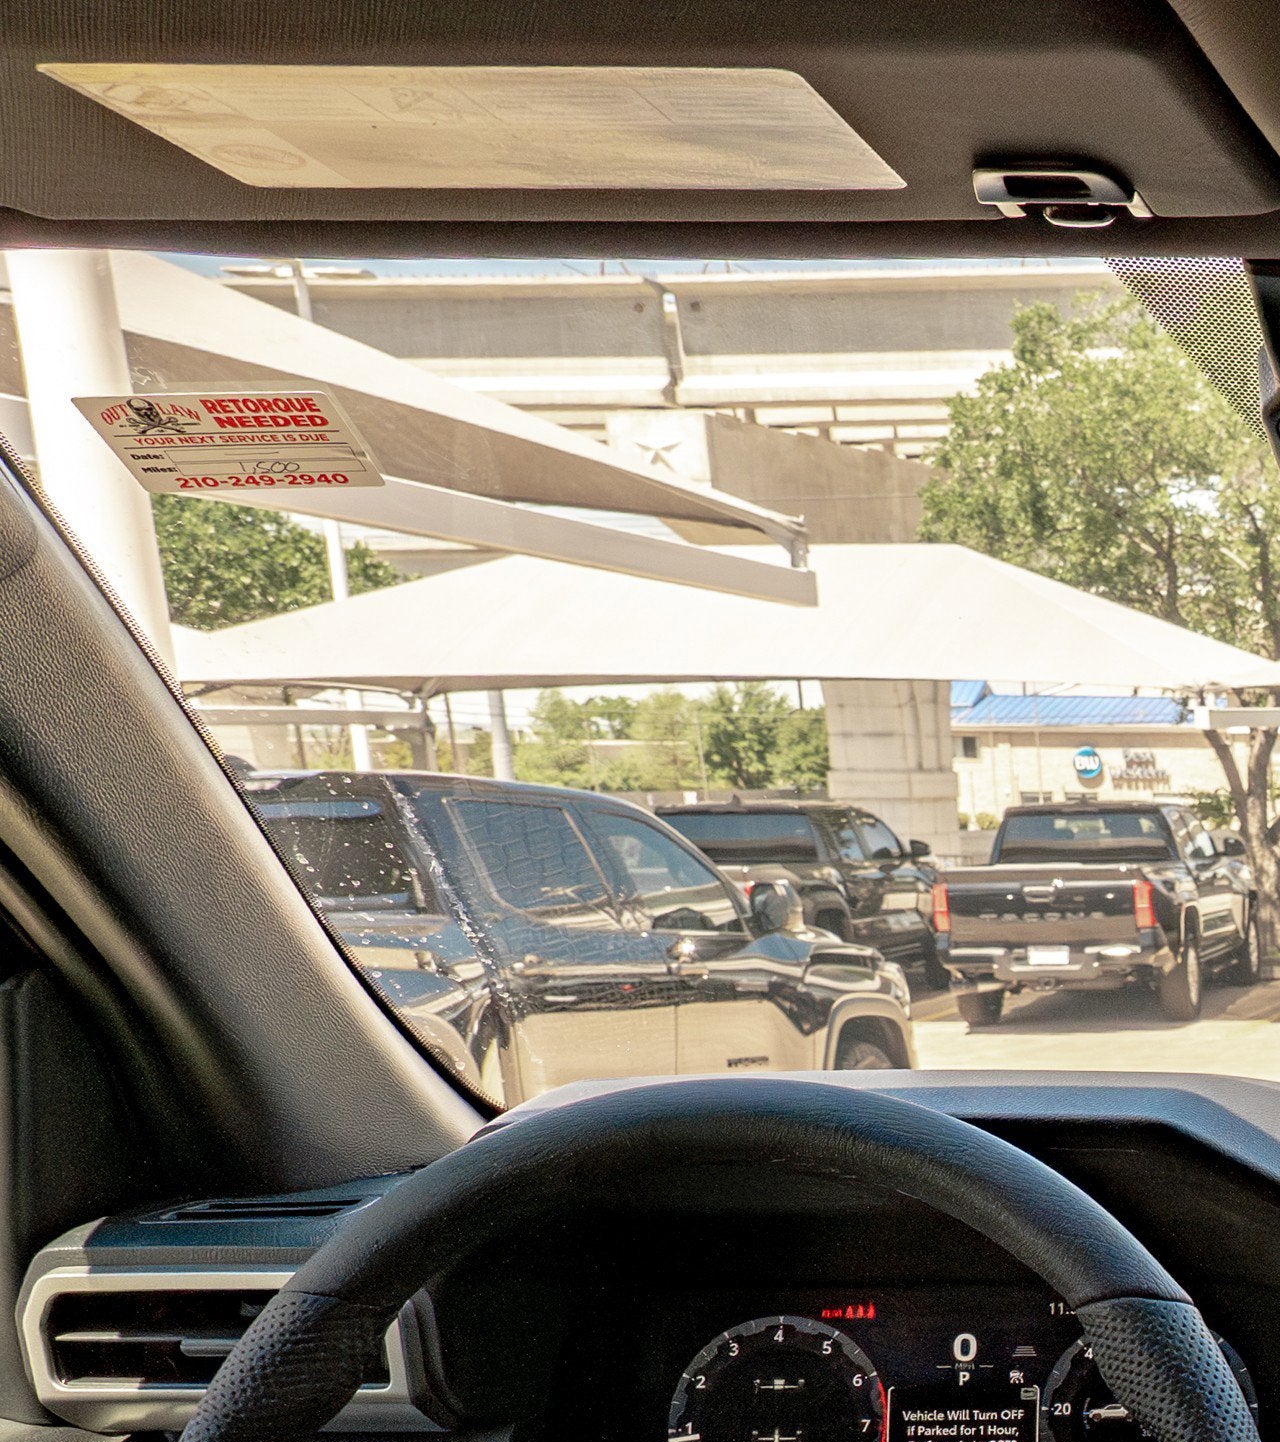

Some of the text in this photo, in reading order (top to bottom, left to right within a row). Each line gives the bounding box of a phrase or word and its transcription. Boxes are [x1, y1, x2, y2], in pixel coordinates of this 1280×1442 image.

[198, 397, 321, 415] RETORQUE
[100, 402, 201, 425] OUT LAW
[213, 415, 329, 429] NEEDED
[134, 434, 330, 447] YOUR NEXT SERVICE IS DUE
[131, 452, 165, 461] Date:
[142, 466, 178, 474] Miles:
[175, 473, 350, 488] 210-249-2940
[774, 1330, 784, 1342] 4
[729, 1341, 832, 1357] 3 5
[953, 1333, 978, 1362] 0
[955, 1362, 975, 1371] MPH
[695, 1374, 863, 1389] 2 6
[958, 1371, 971, 1386] P
[902, 1409, 1025, 1421] Vehicle Will Turn OFF
[1053, 1403, 1072, 1416] 20
[685, 1419, 872, 1435] 1 7
[917, 1425, 958, 1436] Parked
[959, 1425, 977, 1436] for
[978, 1425, 985, 1436] 1
[987, 1425, 1020, 1438] Hour,
